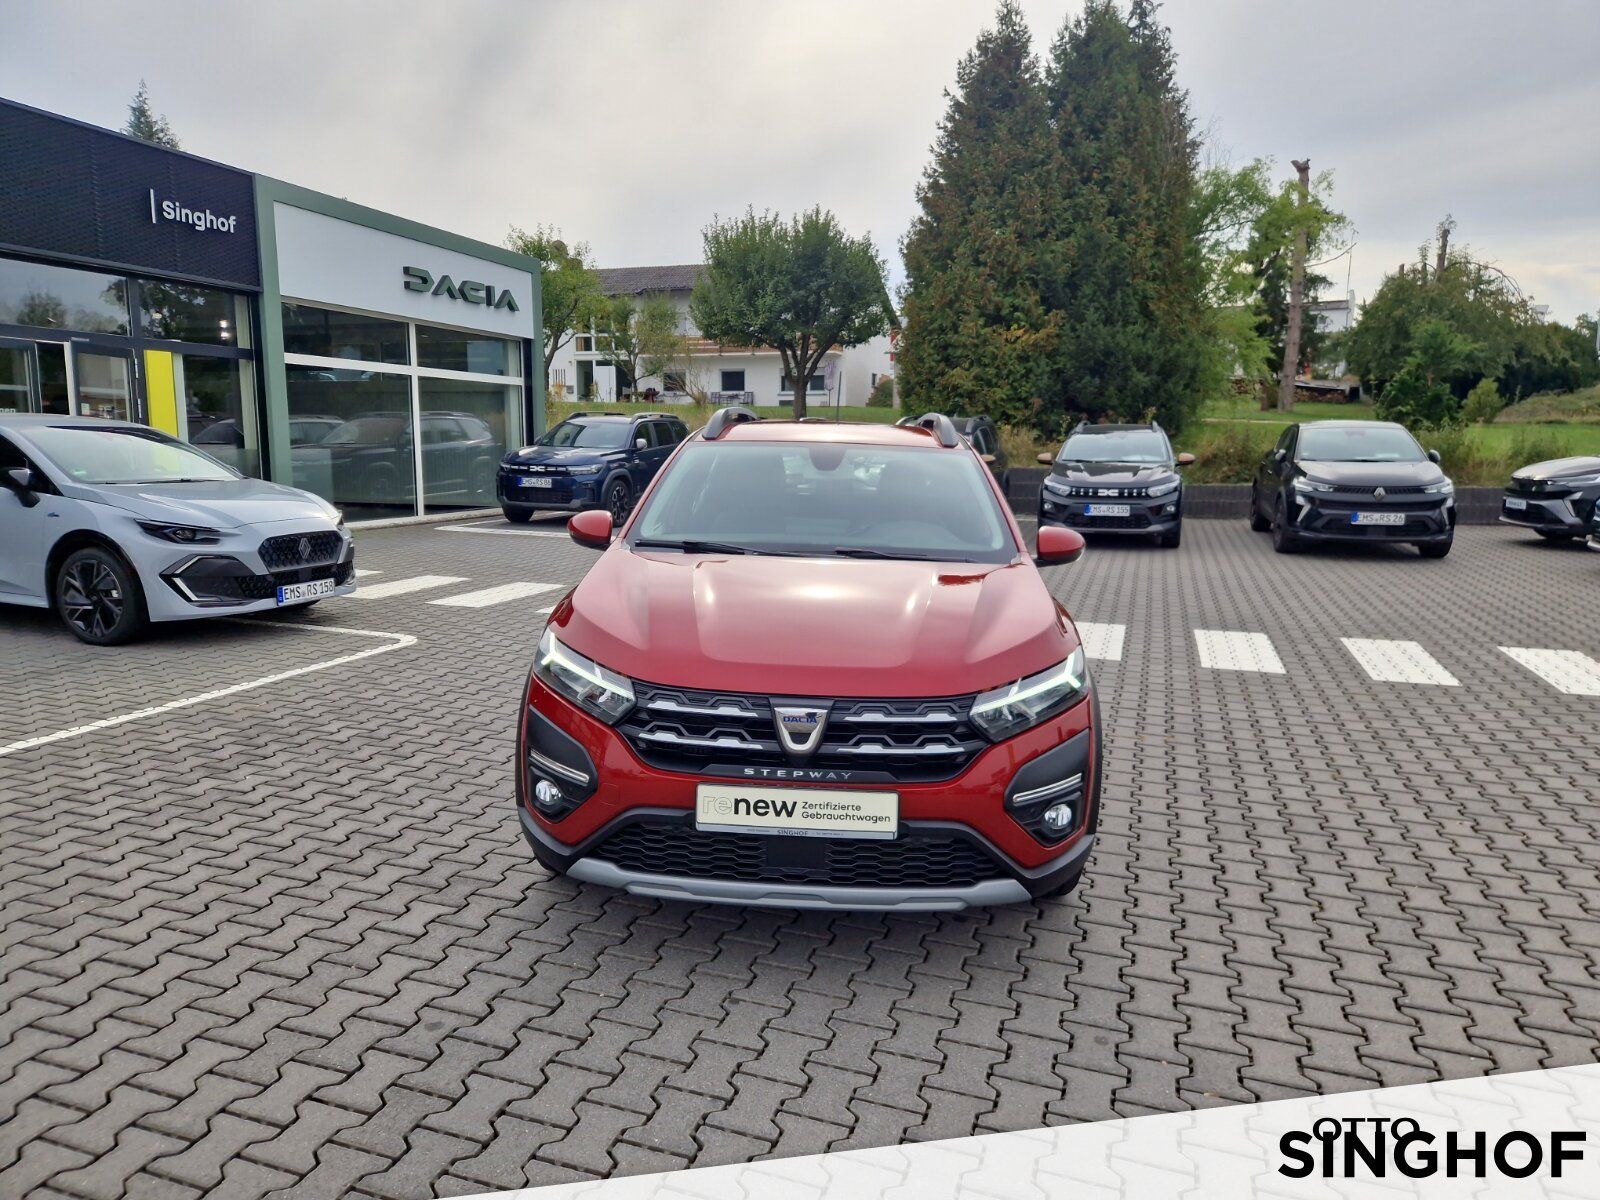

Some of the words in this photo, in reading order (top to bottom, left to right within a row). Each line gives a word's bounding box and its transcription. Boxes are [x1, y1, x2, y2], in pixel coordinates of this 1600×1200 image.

[162, 200, 237, 233] Singhof
[402, 265, 520, 312] DACIA
[1106, 506, 1115, 514] RS
[1116, 506, 1129, 514] 155
[1380, 514, 1391, 522] RS
[1392, 514, 1404, 523] 26
[284, 586, 301, 601] EMS
[306, 583, 318, 596] RS
[319, 580, 334, 594] 158
[783, 715, 818, 724] DACIA
[743, 768, 852, 780] STEPWAY
[801, 801, 862, 812] Zertifizierte
[801, 811, 891, 824] Gebrauchtwagen
[777, 829, 809, 837] SINGHOF
